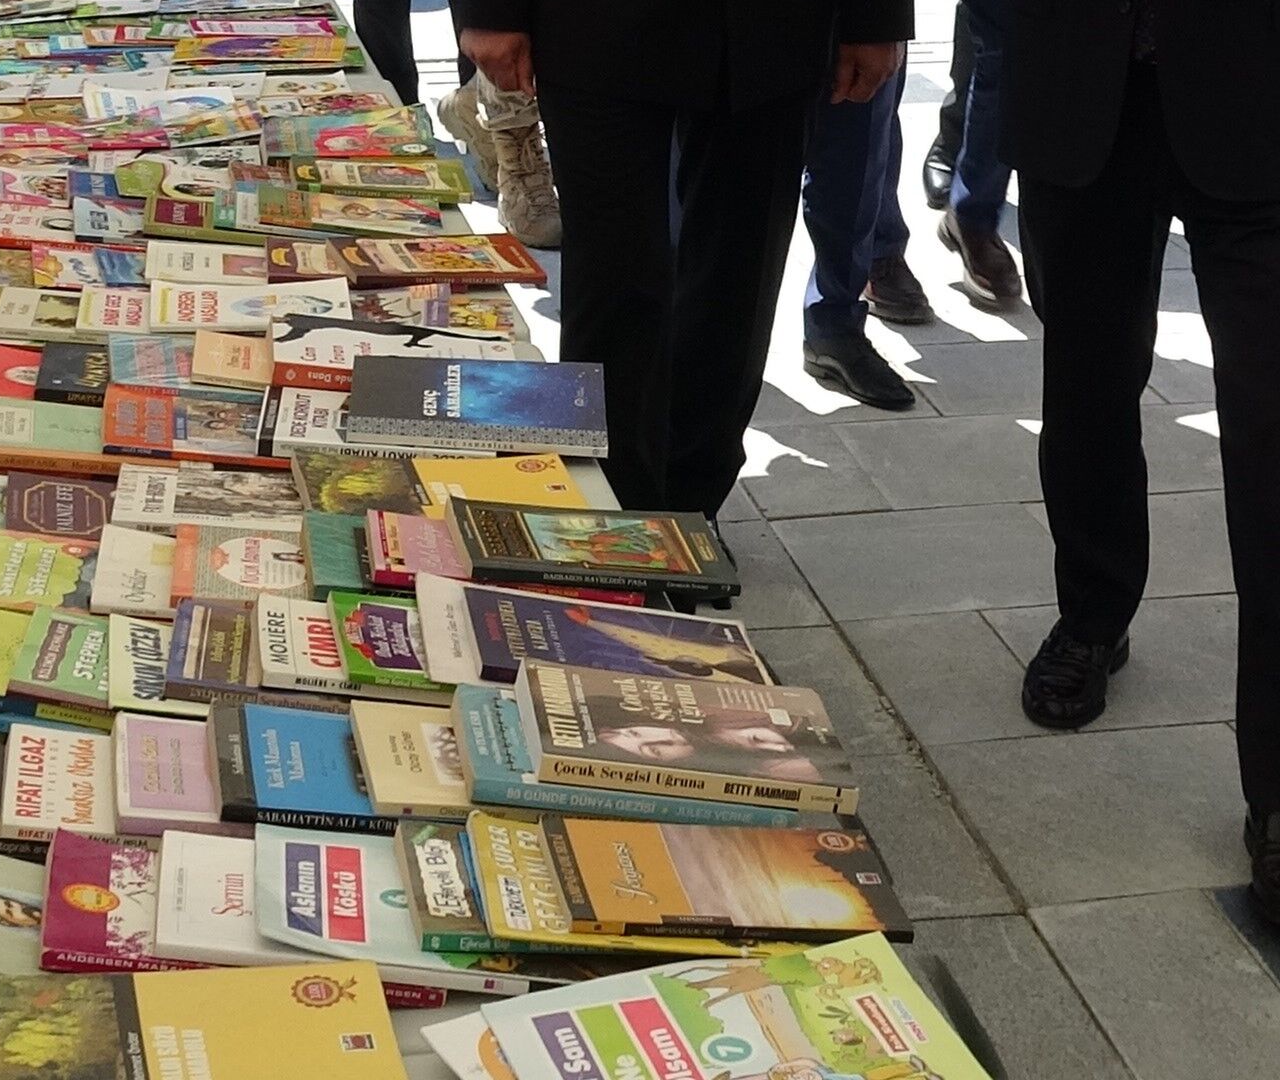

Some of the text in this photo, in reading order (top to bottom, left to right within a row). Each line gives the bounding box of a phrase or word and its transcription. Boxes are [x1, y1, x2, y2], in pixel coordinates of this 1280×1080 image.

[423, 390, 441, 417] GENÇ
[442, 364, 460, 418] SAHABİLER
[73, 630, 104, 680] STEPHEN
[261, 610, 290, 665] MOLIÈRE
[298, 615, 342, 669] CİMRİ
[613, 678, 649, 712] Çocuk
[642, 679, 676, 723] Sevgisi
[673, 683, 706, 724] Uğruna
[547, 715, 584, 749] BETTY
[15, 735, 47, 819] RIFAT ILGAZ
[523, 788, 568, 805] GÜNDE
[553, 761, 596, 778] Çocuk
[600, 765, 651, 785] Sevgisi
[655, 770, 705, 790] Uğruna
[723, 781, 752, 797] BETTY
[257, 810, 335, 827] SABAHATTİN
[338, 815, 357, 829] ALİ
[488, 824, 517, 871] SÜPER
[290, 861, 317, 918] Aslanın
[331, 870, 360, 918] Köşkü
[56, 953, 134, 968] ANDERSEN
[554, 1026, 591, 1073] Sam
